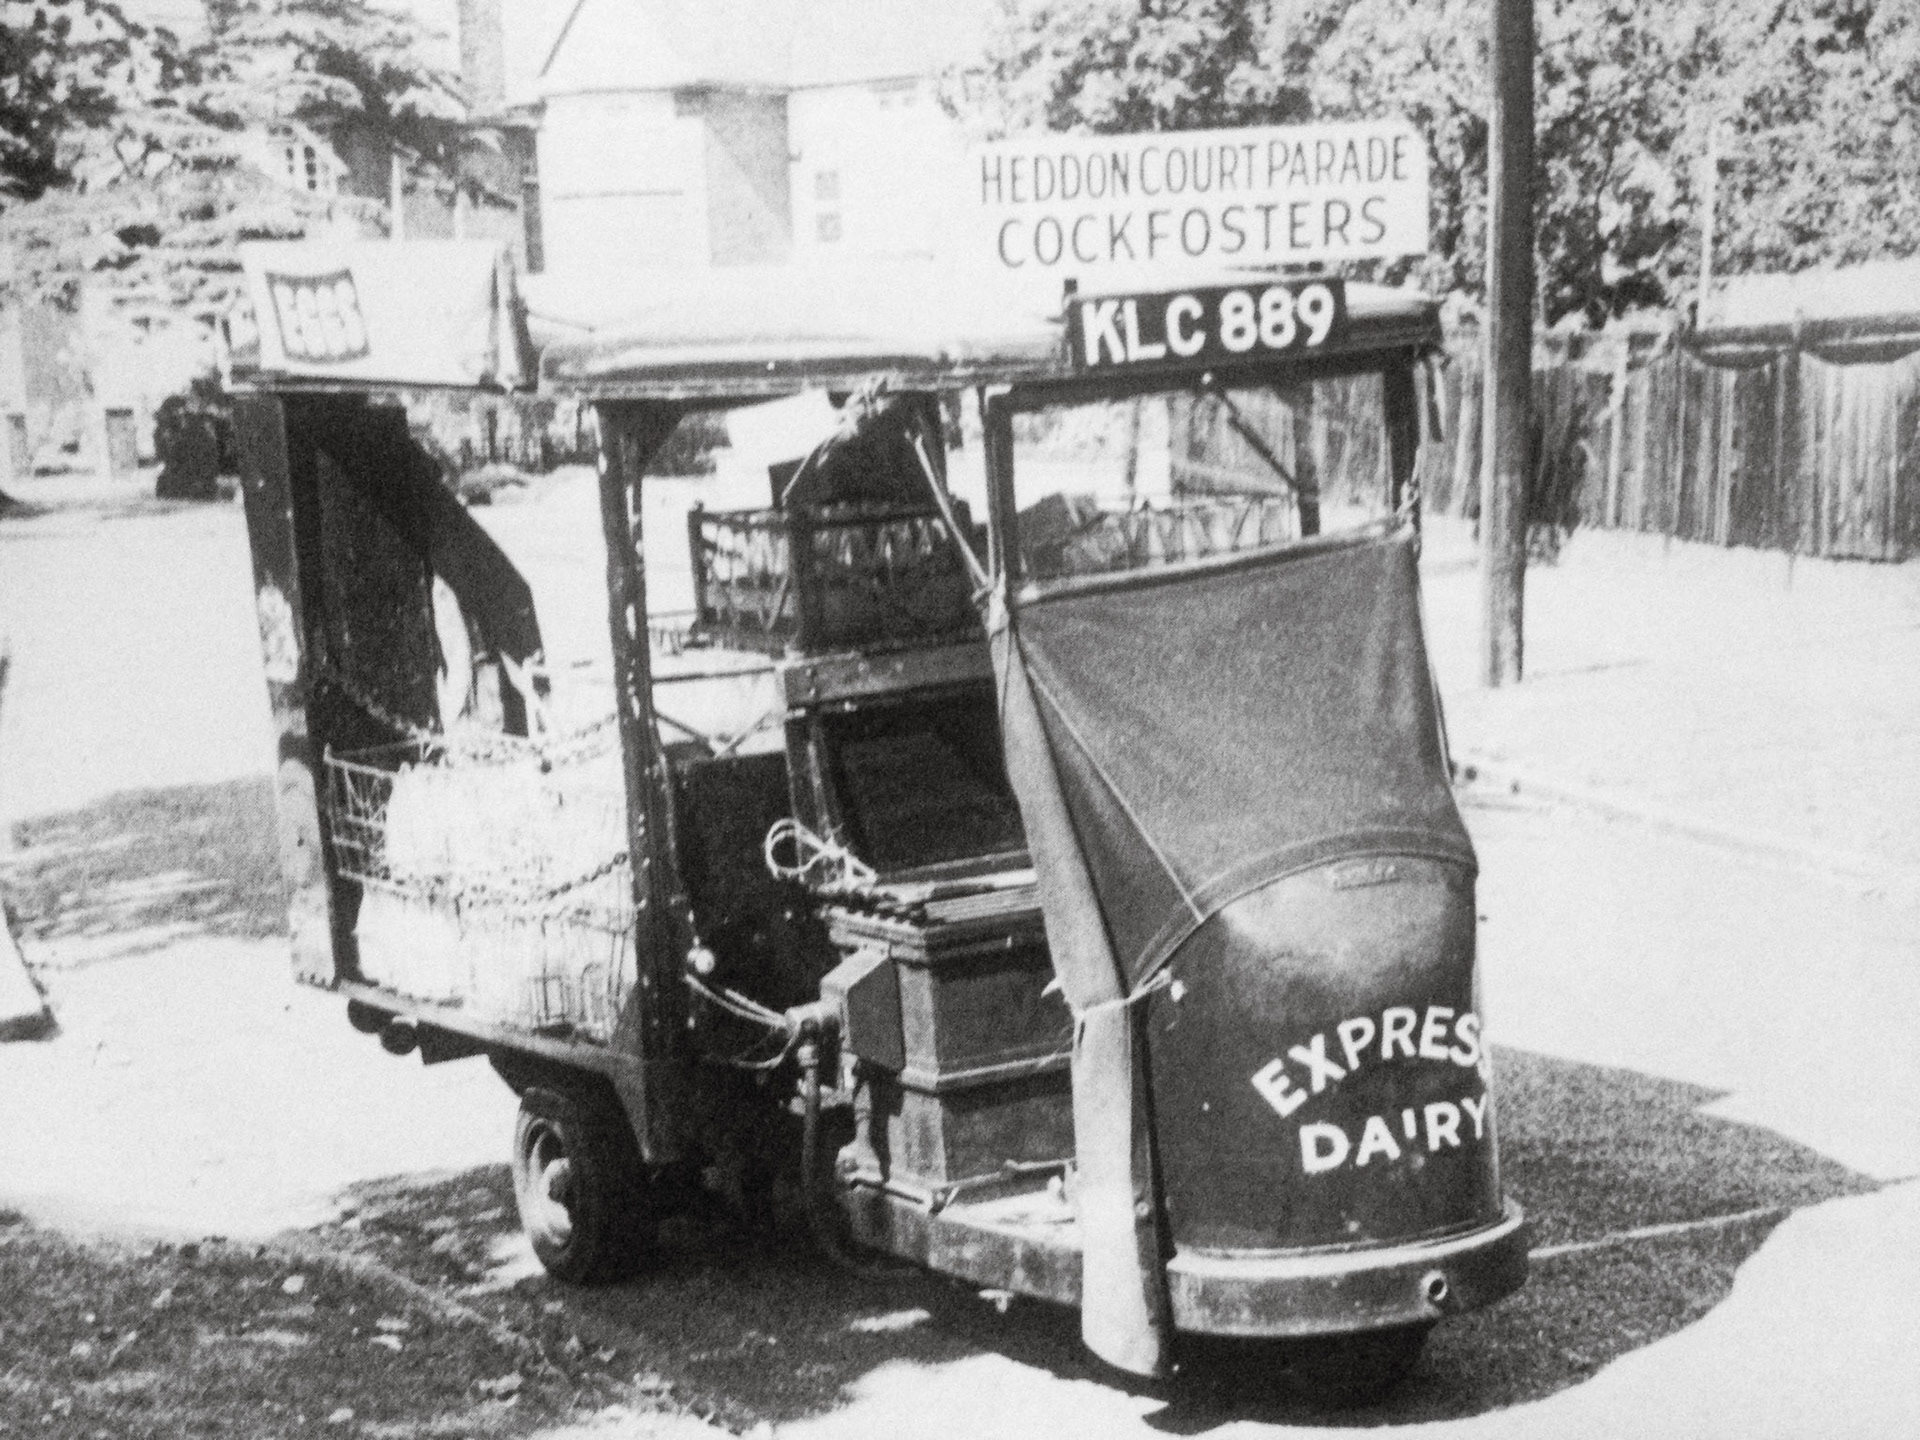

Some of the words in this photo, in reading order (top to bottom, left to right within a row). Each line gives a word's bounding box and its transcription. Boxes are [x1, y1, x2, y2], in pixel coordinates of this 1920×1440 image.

[981, 151, 1130, 204] HEDDON
[1139, 144, 1257, 196] COURT
[1267, 134, 1409, 188] PARADE
[998, 196, 1387, 268] COCKFOSTERS
[1081, 294, 1207, 366] KLC
[1219, 284, 1335, 352] 889
[1299, 1093, 1488, 1175] DAIRY
